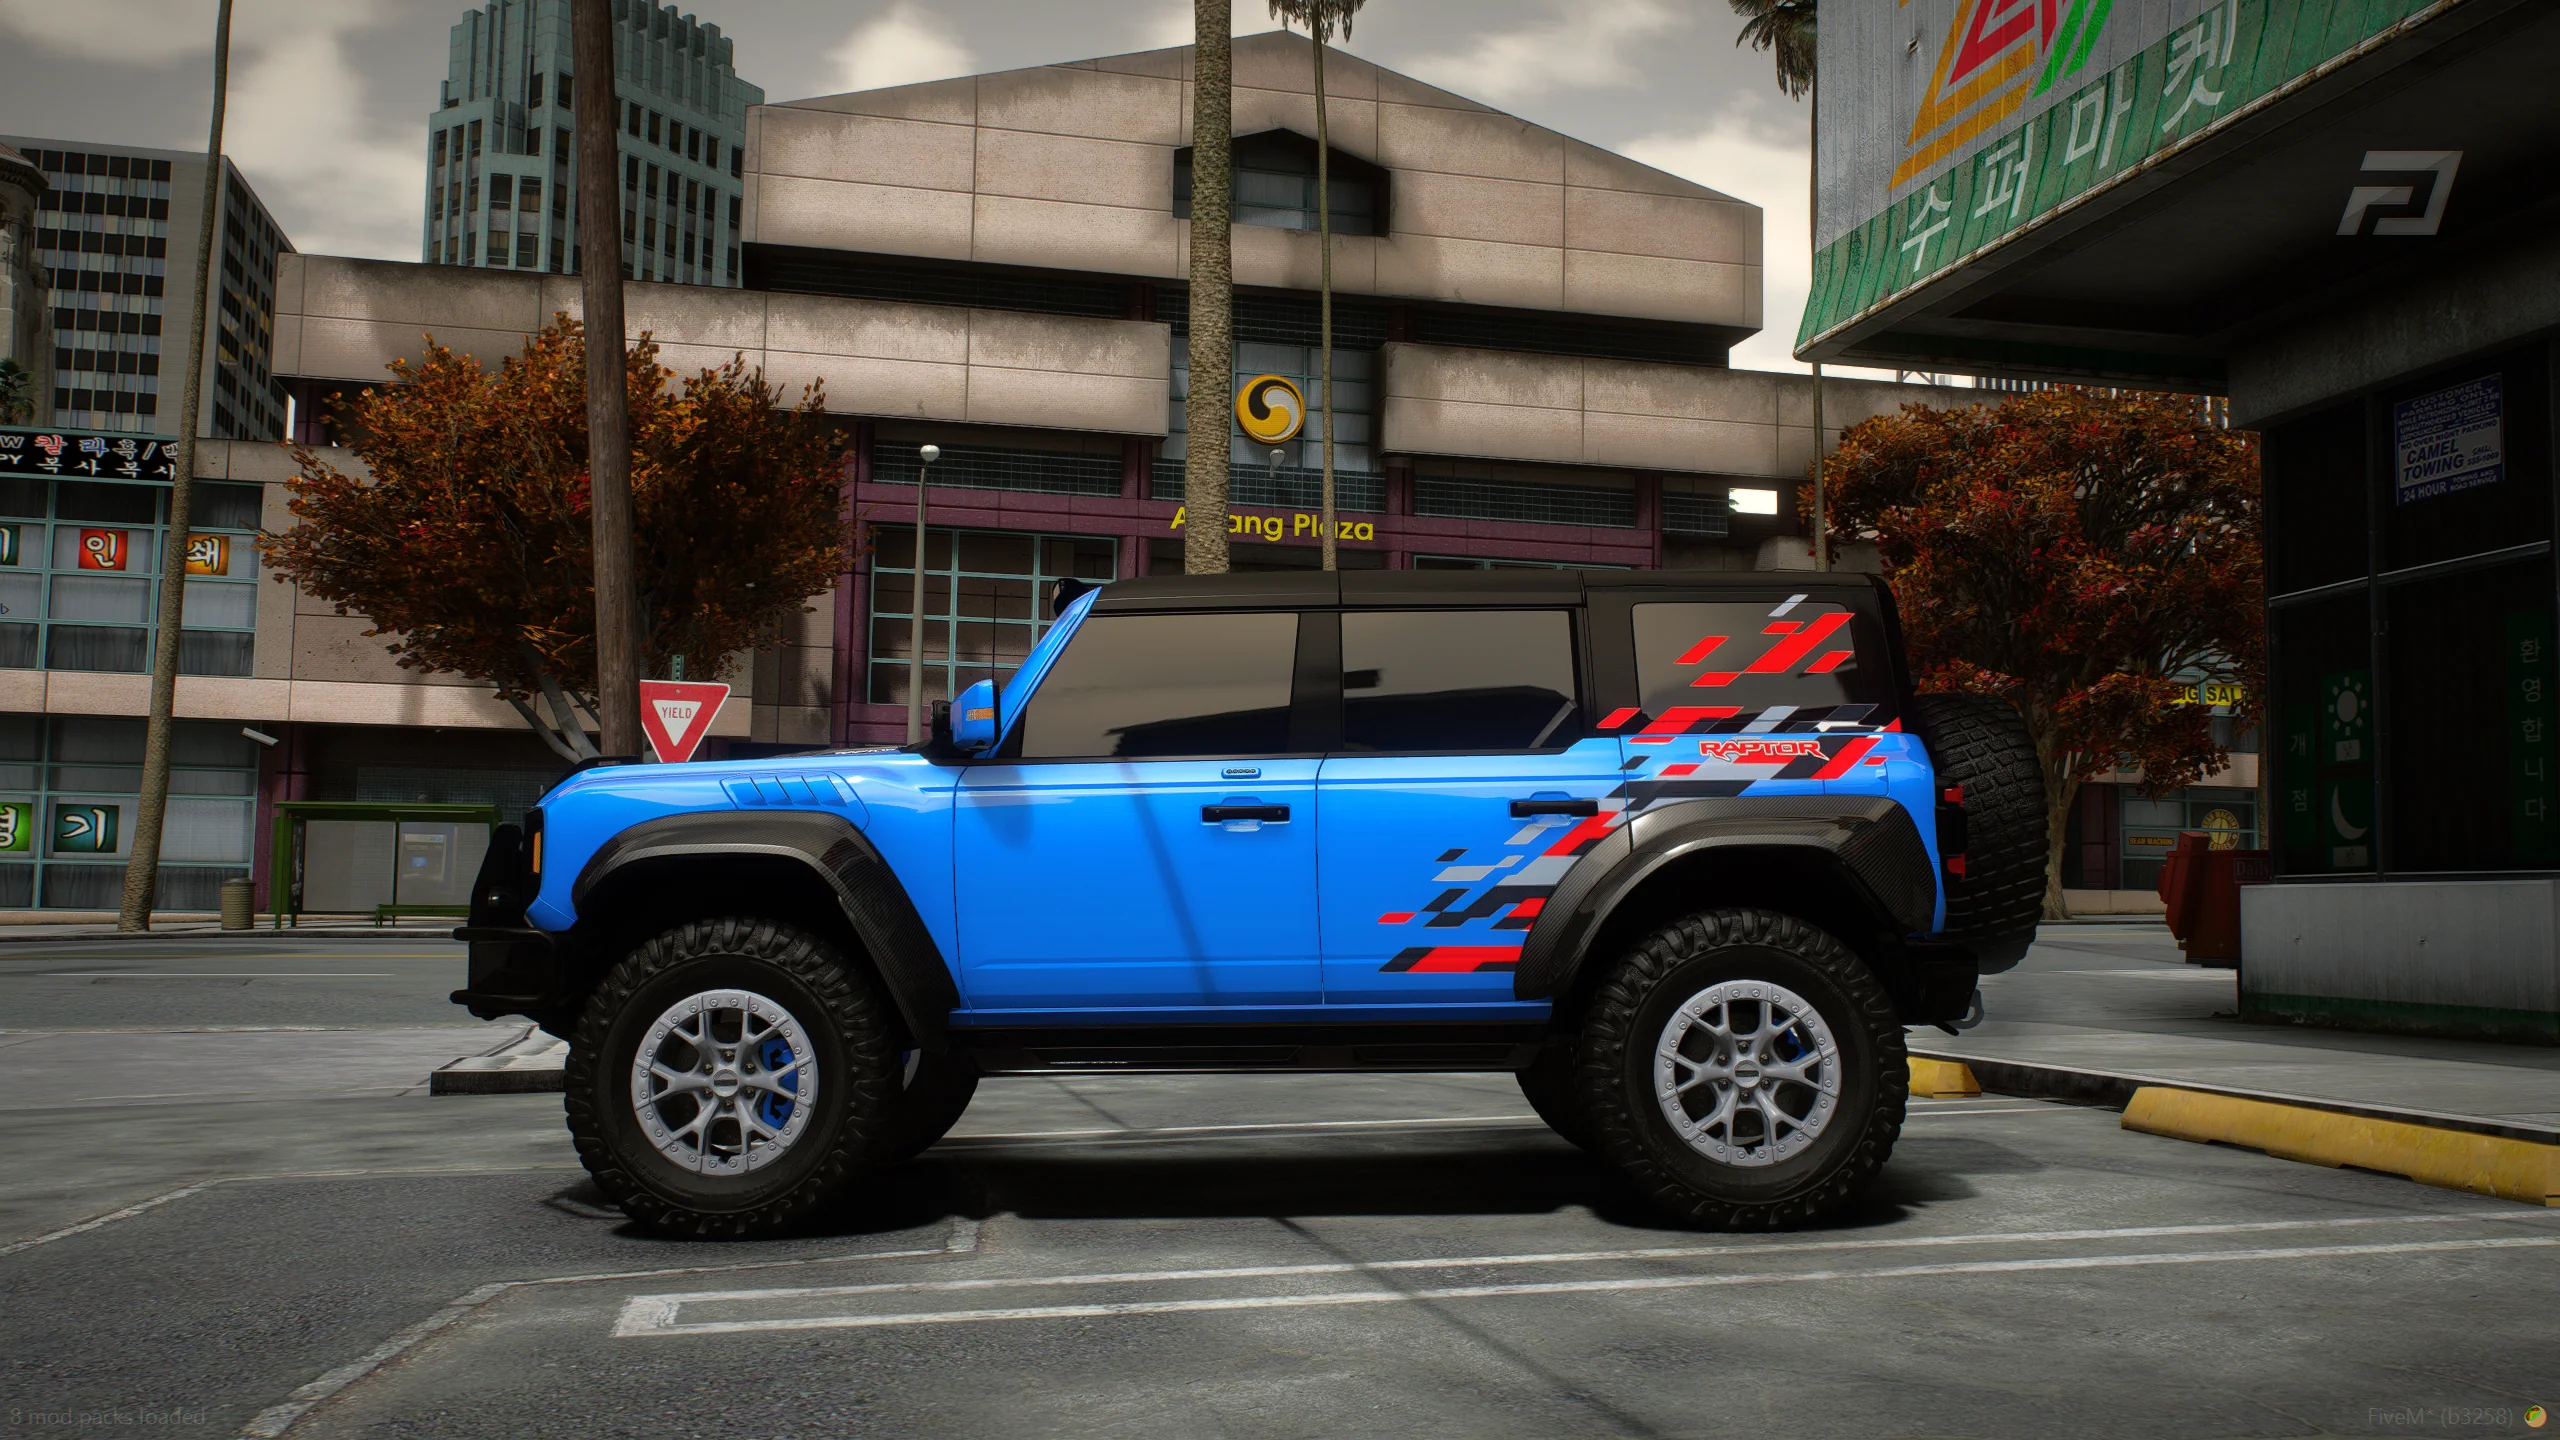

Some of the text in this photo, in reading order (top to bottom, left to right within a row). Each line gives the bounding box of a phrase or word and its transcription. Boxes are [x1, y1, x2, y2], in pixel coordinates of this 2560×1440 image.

[1901, 0, 2238, 273] 수퍼마켓
[2412, 382, 2483, 409] CUSTOMER
[2460, 385, 2495, 402] ONLY
[2413, 436, 2434, 448] OVER
[2435, 429, 2460, 442] NIGHT
[2462, 418, 2498, 434] PARKING
[2406, 438, 2459, 465] CAMEL
[2403, 453, 2465, 482] TOWING
[2404, 481, 2447, 503] 24 HOUR
[661, 706, 692, 720] YIELD
[2518, 635, 2548, 824] 환영합니다
[1698, 740, 1830, 762] RAPTOR
[2129, 837, 2174, 847] BEAN MACHINE
